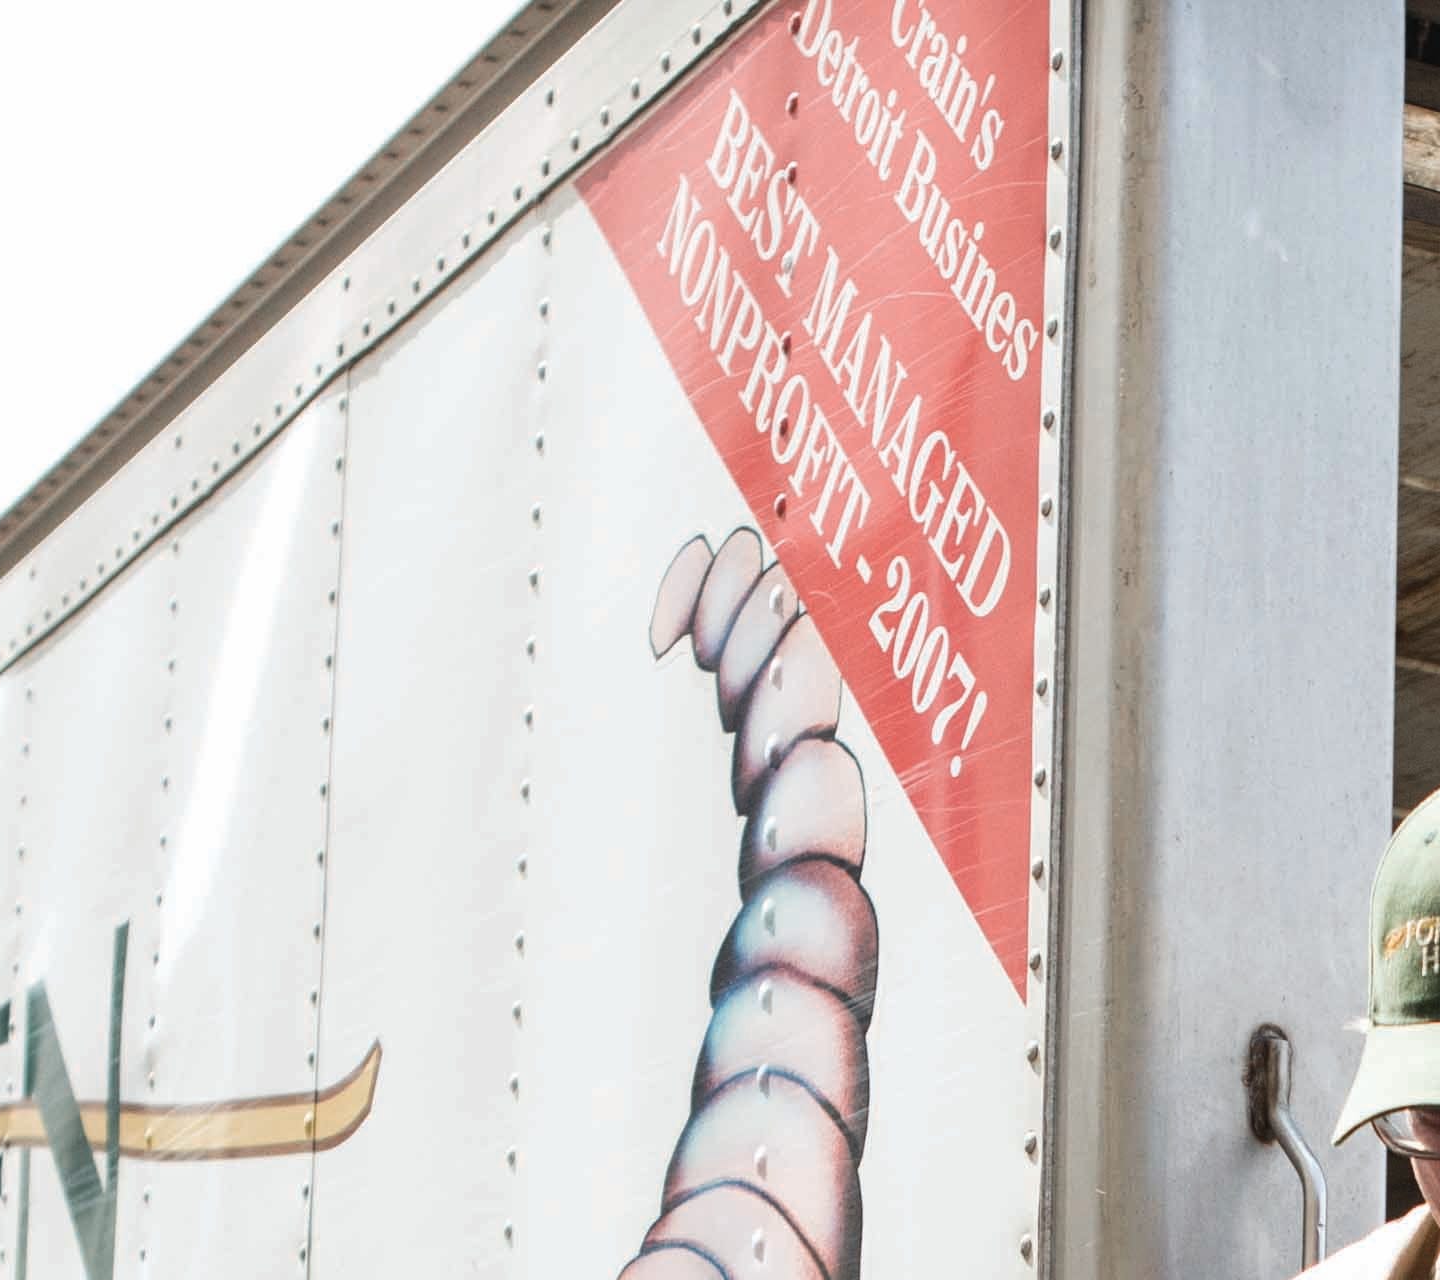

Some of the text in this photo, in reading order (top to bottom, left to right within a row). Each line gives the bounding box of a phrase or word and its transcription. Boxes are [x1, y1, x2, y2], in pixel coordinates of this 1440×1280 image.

[706, 88, 1011, 617] BEST MANAGED
[794, 0, 906, 181] Detroit
[656, 174, 871, 569] NONPROFIT
[868, 555, 987, 778] 2007!
